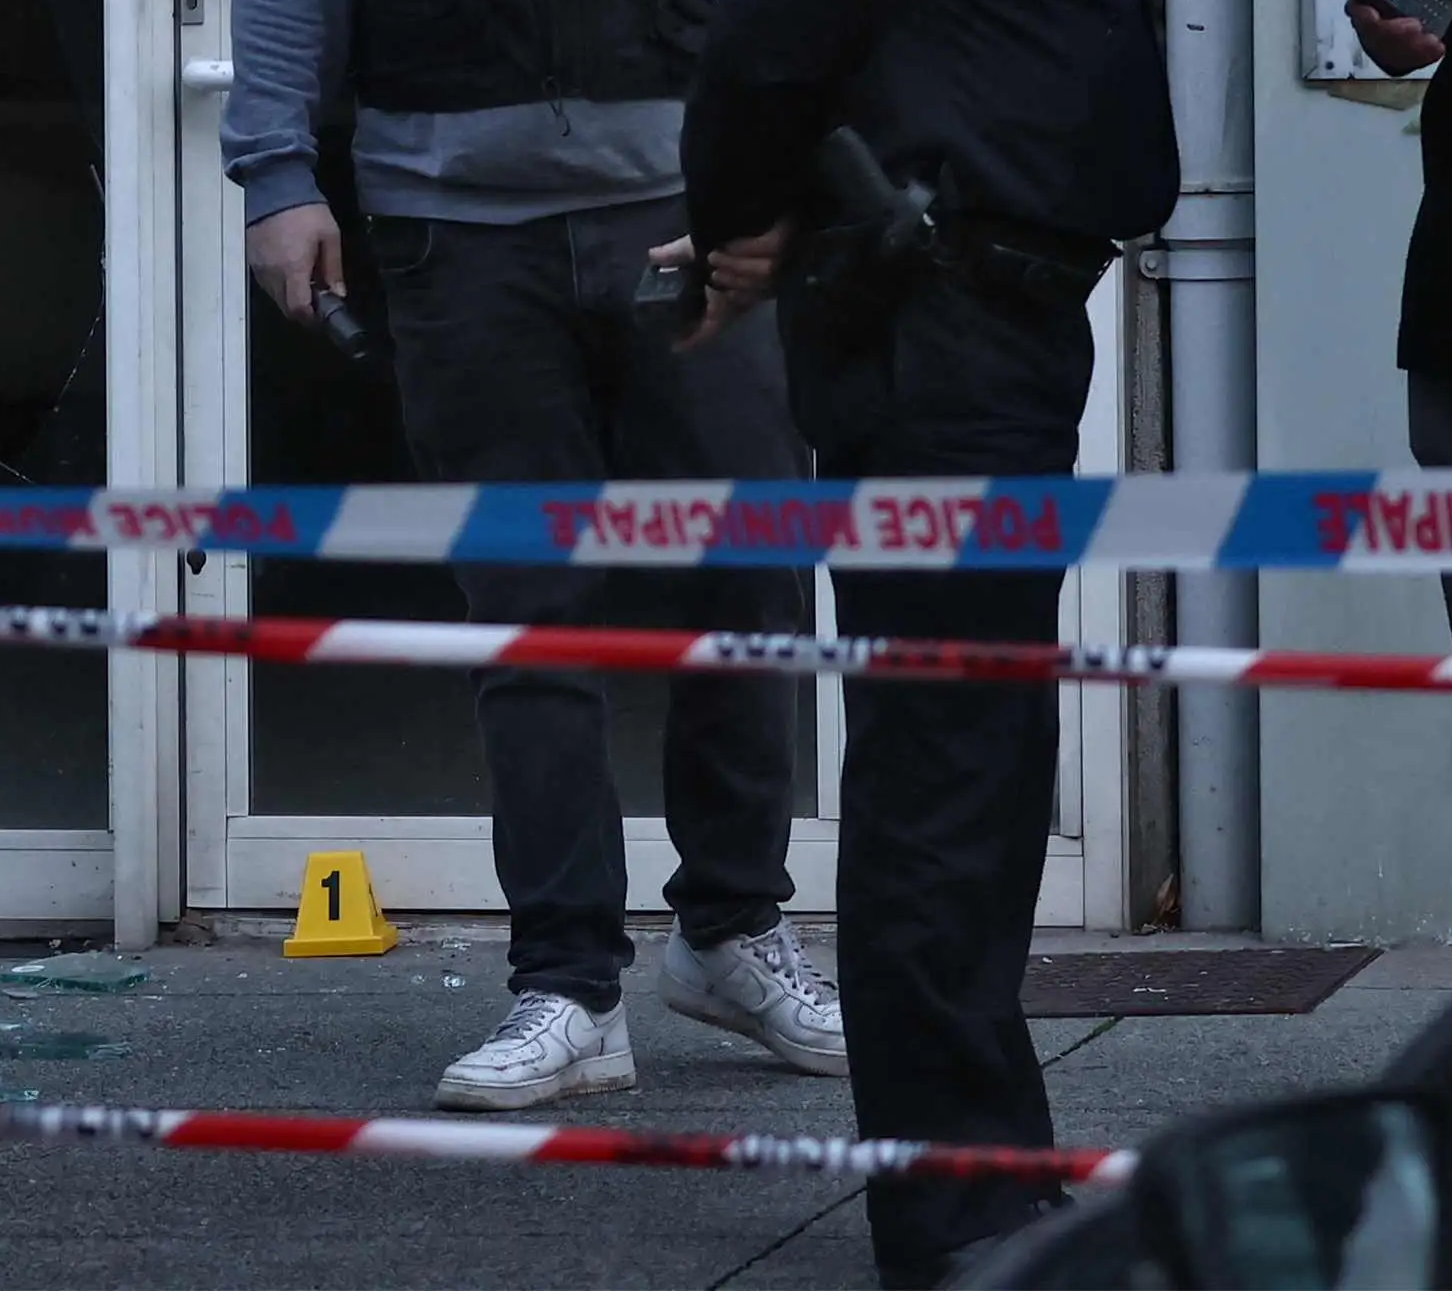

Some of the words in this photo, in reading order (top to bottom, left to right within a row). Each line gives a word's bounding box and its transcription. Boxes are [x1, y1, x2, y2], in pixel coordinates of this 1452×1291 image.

[106, 501, 297, 544] POLICE
[542, 498, 860, 551] MUNICIPALE
[875, 495, 1061, 553] POLICE
[319, 871, 342, 921] 1
